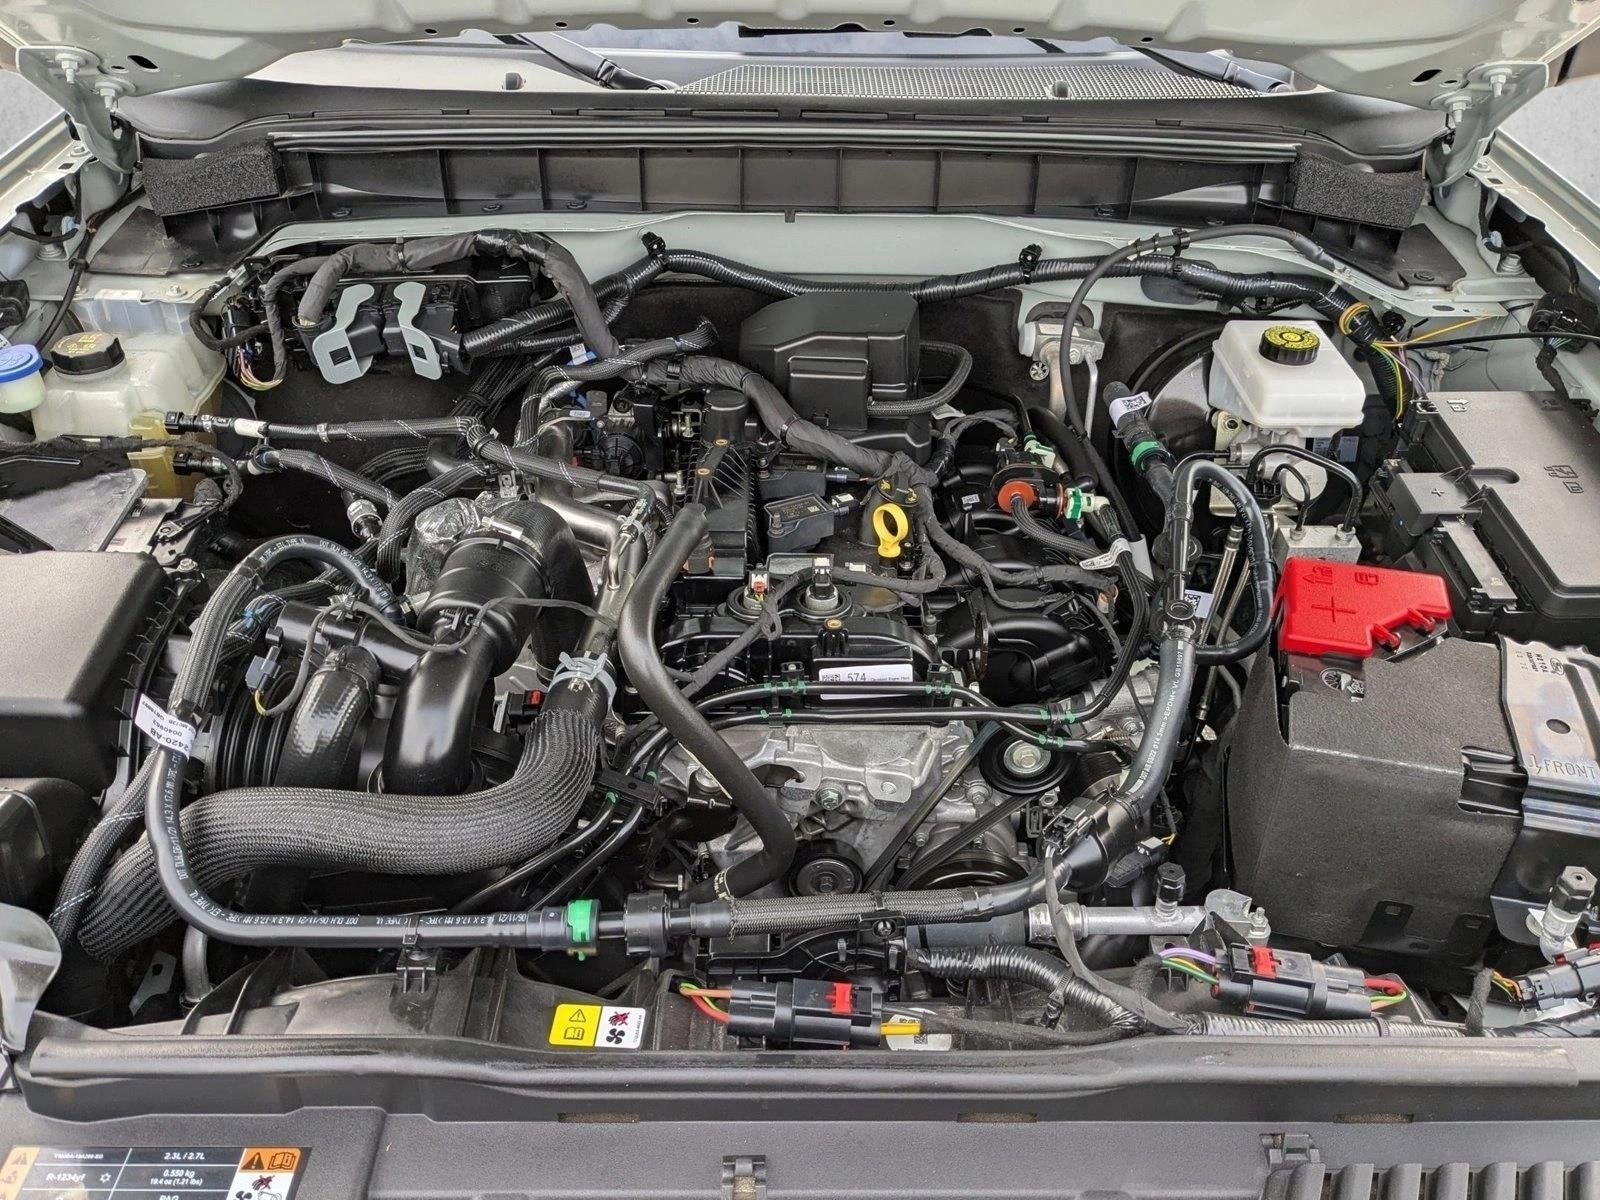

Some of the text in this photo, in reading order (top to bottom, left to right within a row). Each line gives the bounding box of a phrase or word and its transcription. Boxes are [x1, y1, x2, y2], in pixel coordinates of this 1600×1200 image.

[1544, 759, 1596, 779] FRONT
[164, 1152, 181, 1160] 2.3L
[189, 1152, 205, 1160] 2.7L
[46, 1172, 86, 1182] R-1234yf
[185, 1170, 195, 1179] kg
